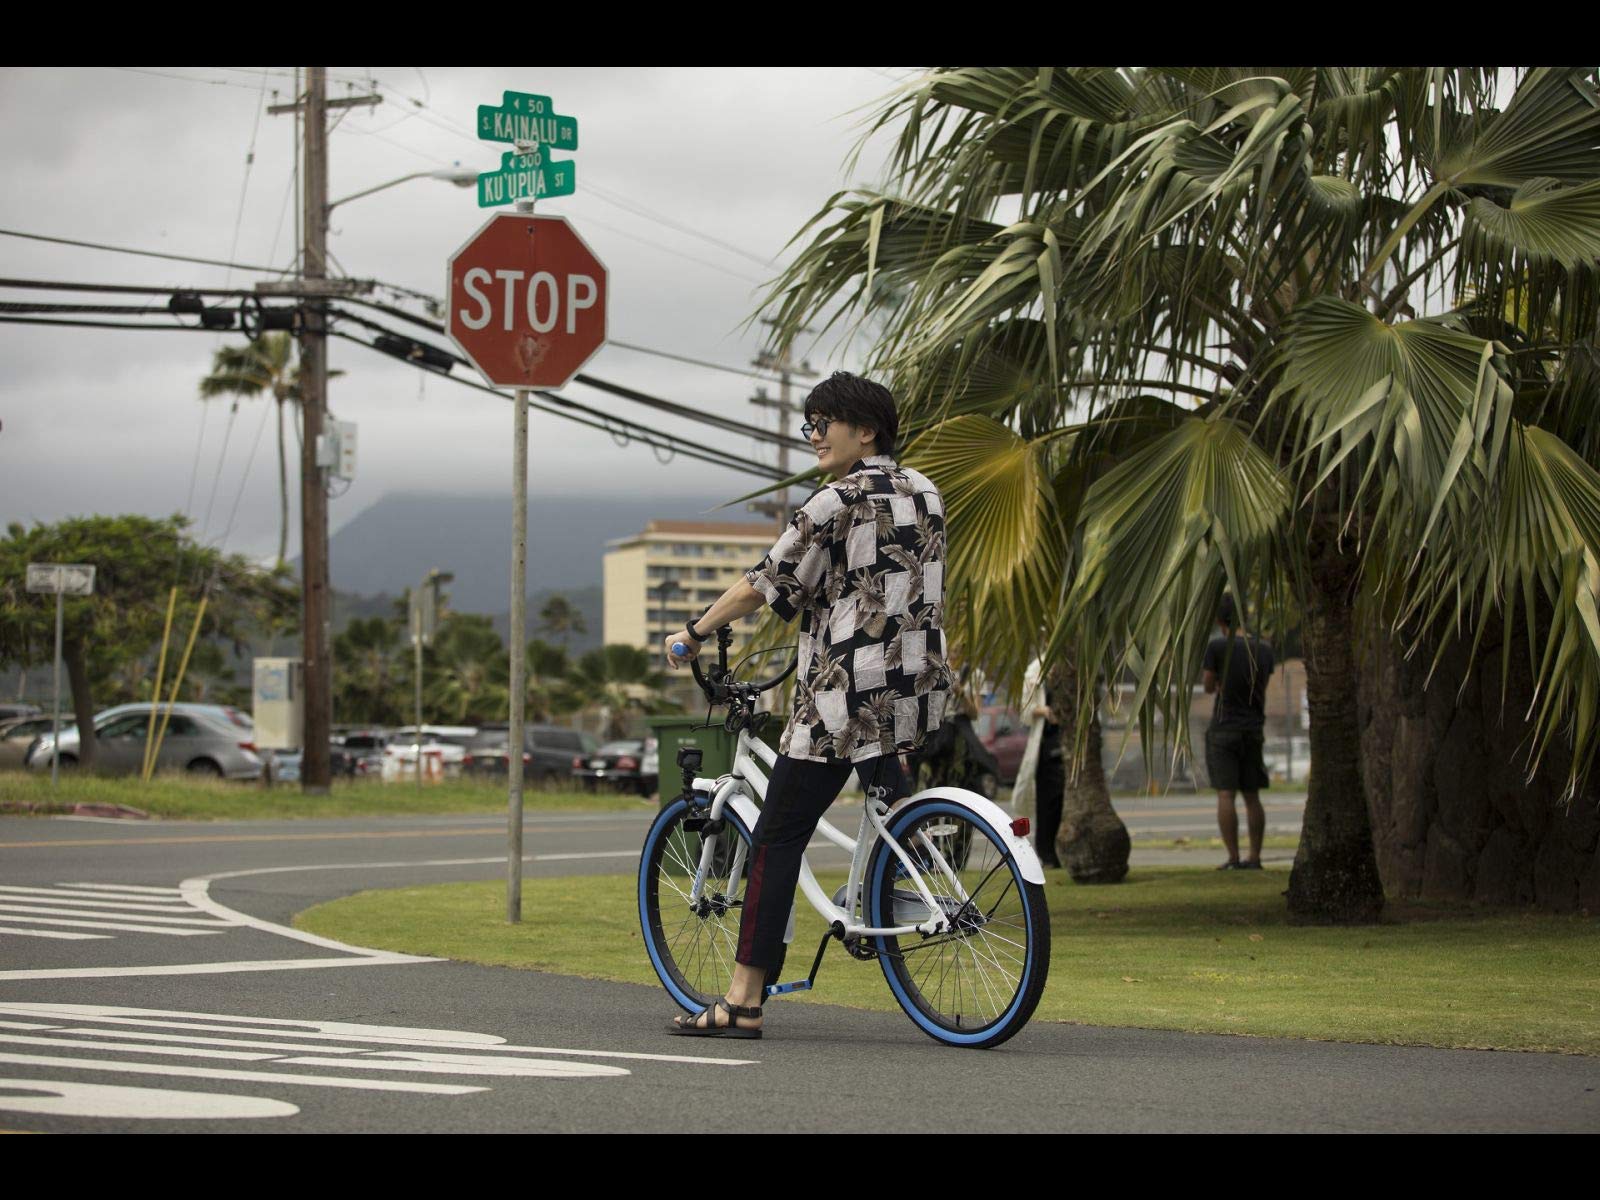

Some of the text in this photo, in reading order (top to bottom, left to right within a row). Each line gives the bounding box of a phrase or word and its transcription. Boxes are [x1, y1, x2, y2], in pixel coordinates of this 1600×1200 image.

[528, 100, 544, 114] 50
[494, 112, 557, 144] KAINALU
[561, 127, 572, 141] DR
[519, 153, 542, 168] 300
[554, 173, 565, 187] ST
[460, 267, 598, 334] STOP
